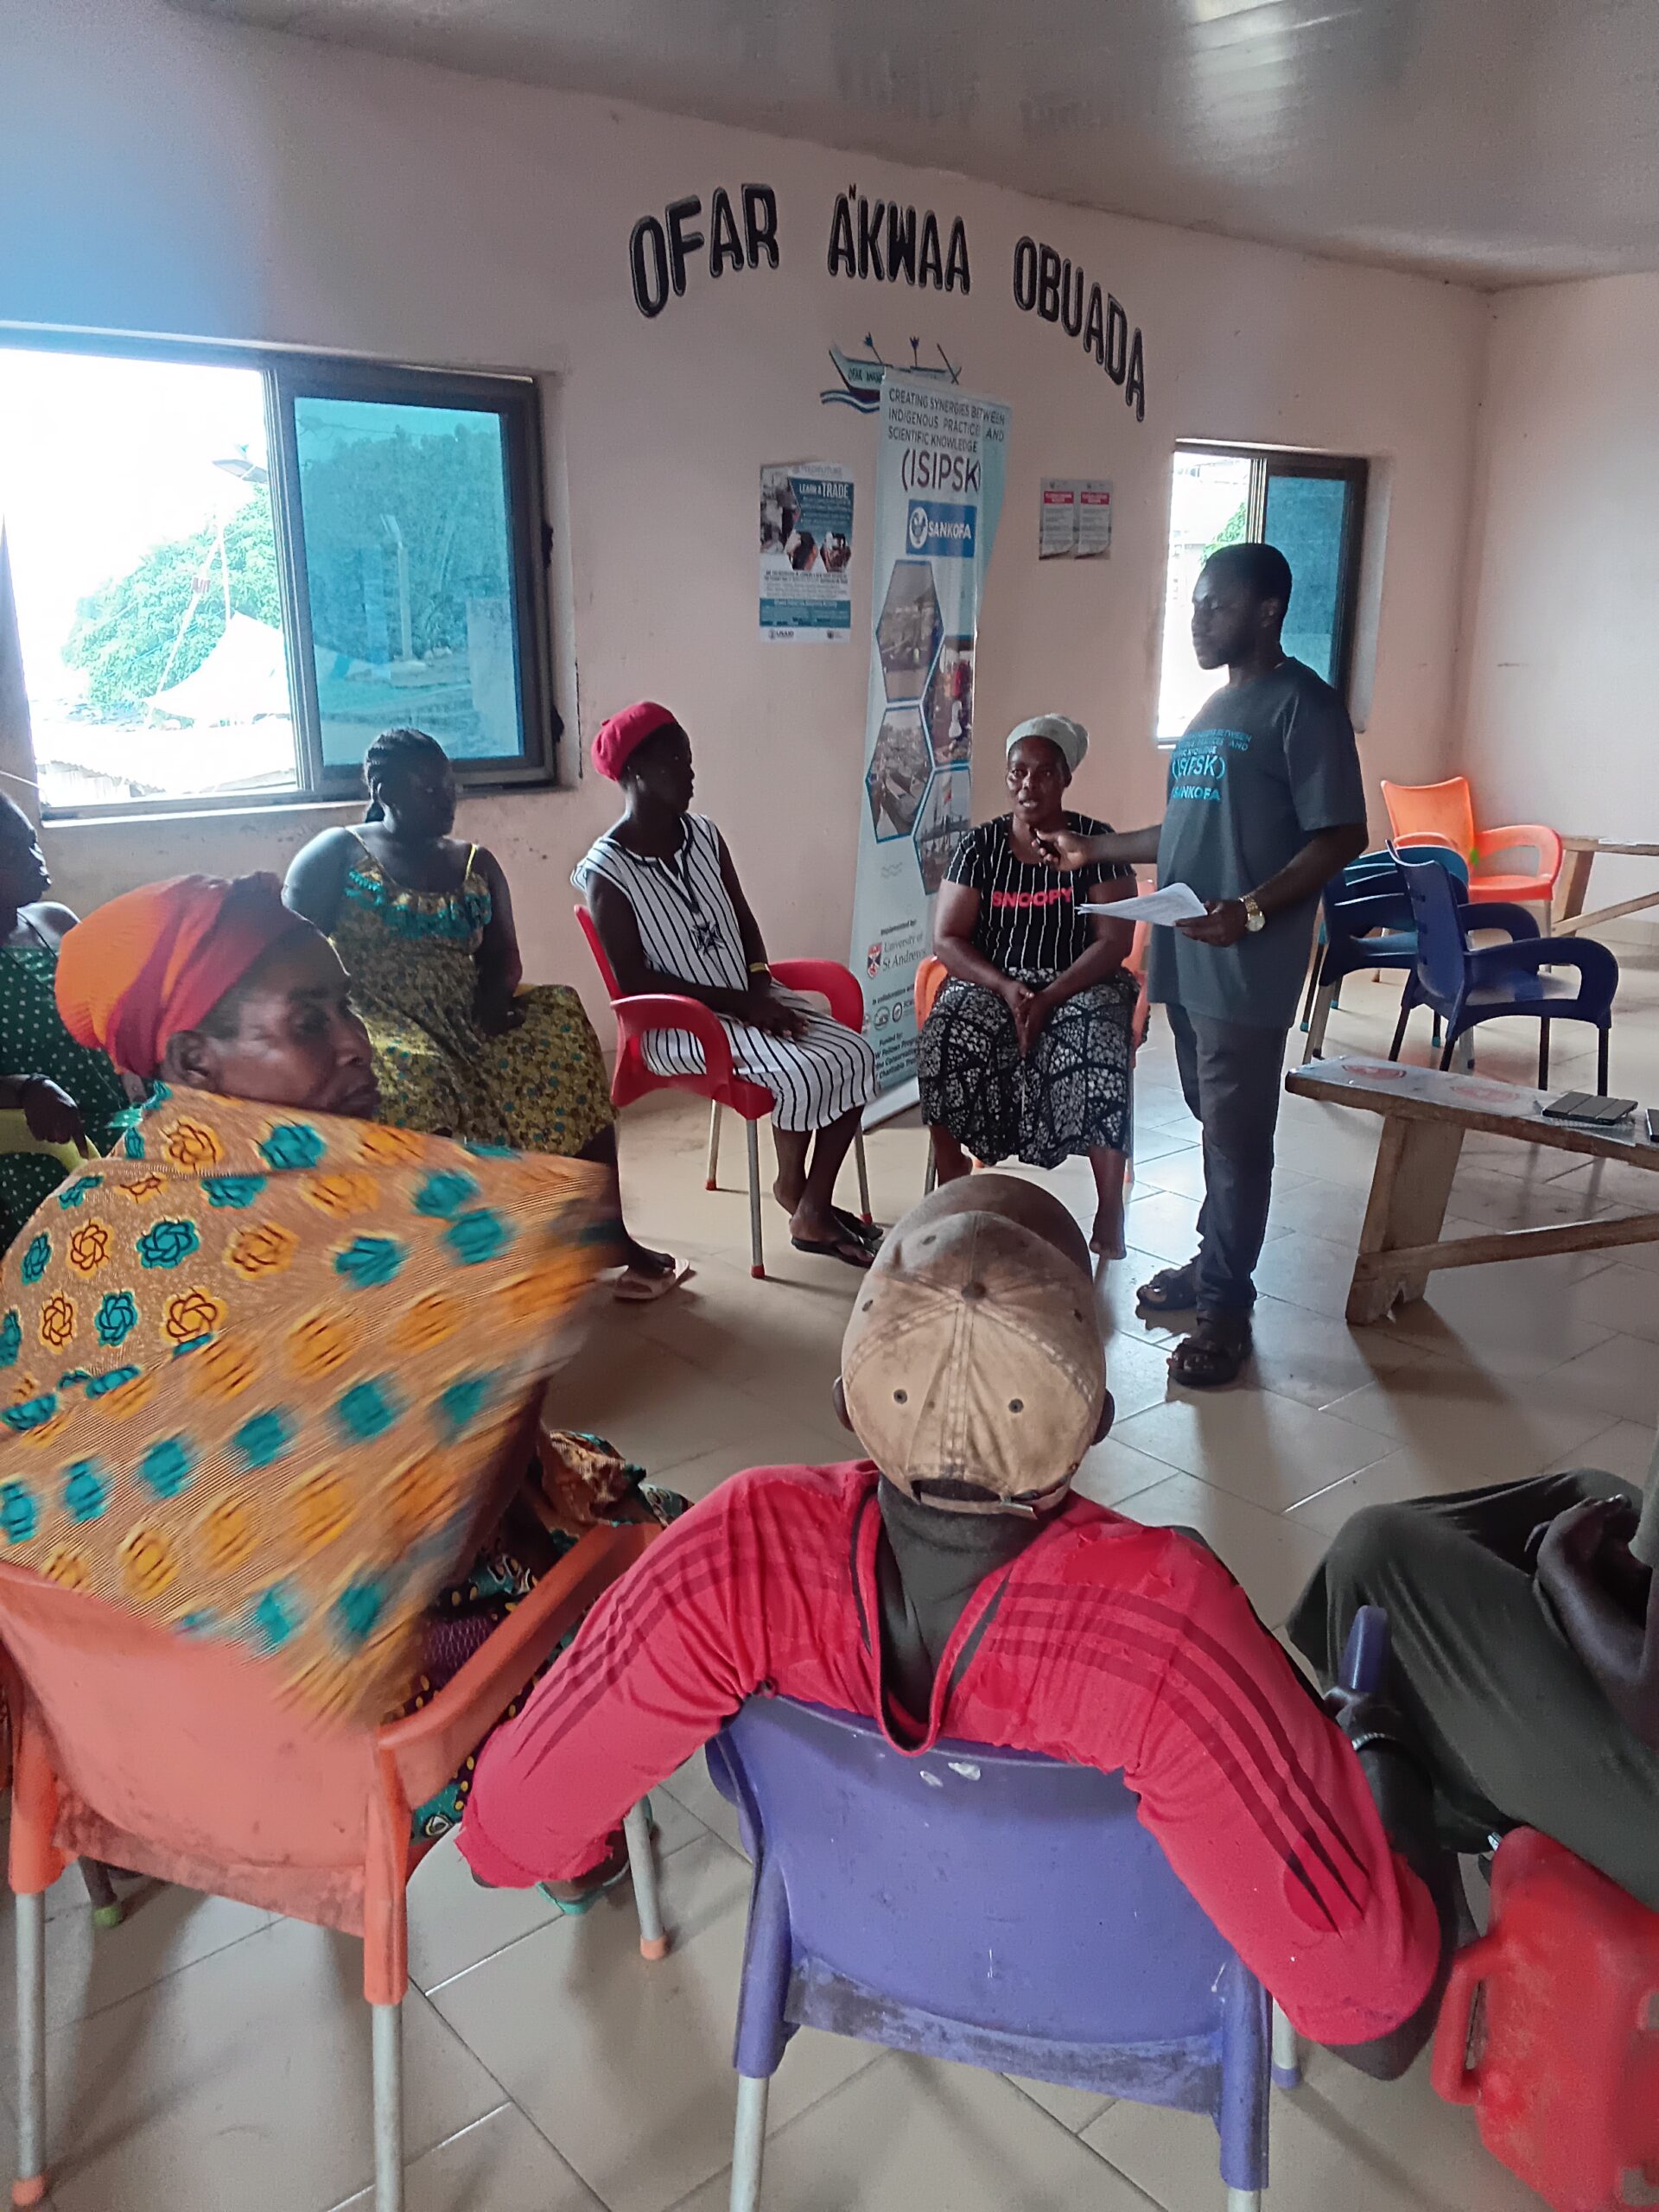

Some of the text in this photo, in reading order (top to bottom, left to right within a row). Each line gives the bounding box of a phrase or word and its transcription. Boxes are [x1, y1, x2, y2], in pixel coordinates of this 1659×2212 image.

[629, 183, 779, 318] OFAR
[1014, 236, 1145, 423] OBUADA
[888, 388, 1005, 425] CREATING SYNERGIES BETWEEN
[888, 408, 938, 429] INDIGENOUS
[986, 428, 1004, 442] AND
[888, 425, 977, 453] SCIENTIFIC KNOWLEDGE
[822, 481, 849, 499] TRADE
[927, 521, 972, 540] SANKOFA
[992, 885, 1073, 908] SNOOPY
[883, 957, 891, 969] St
